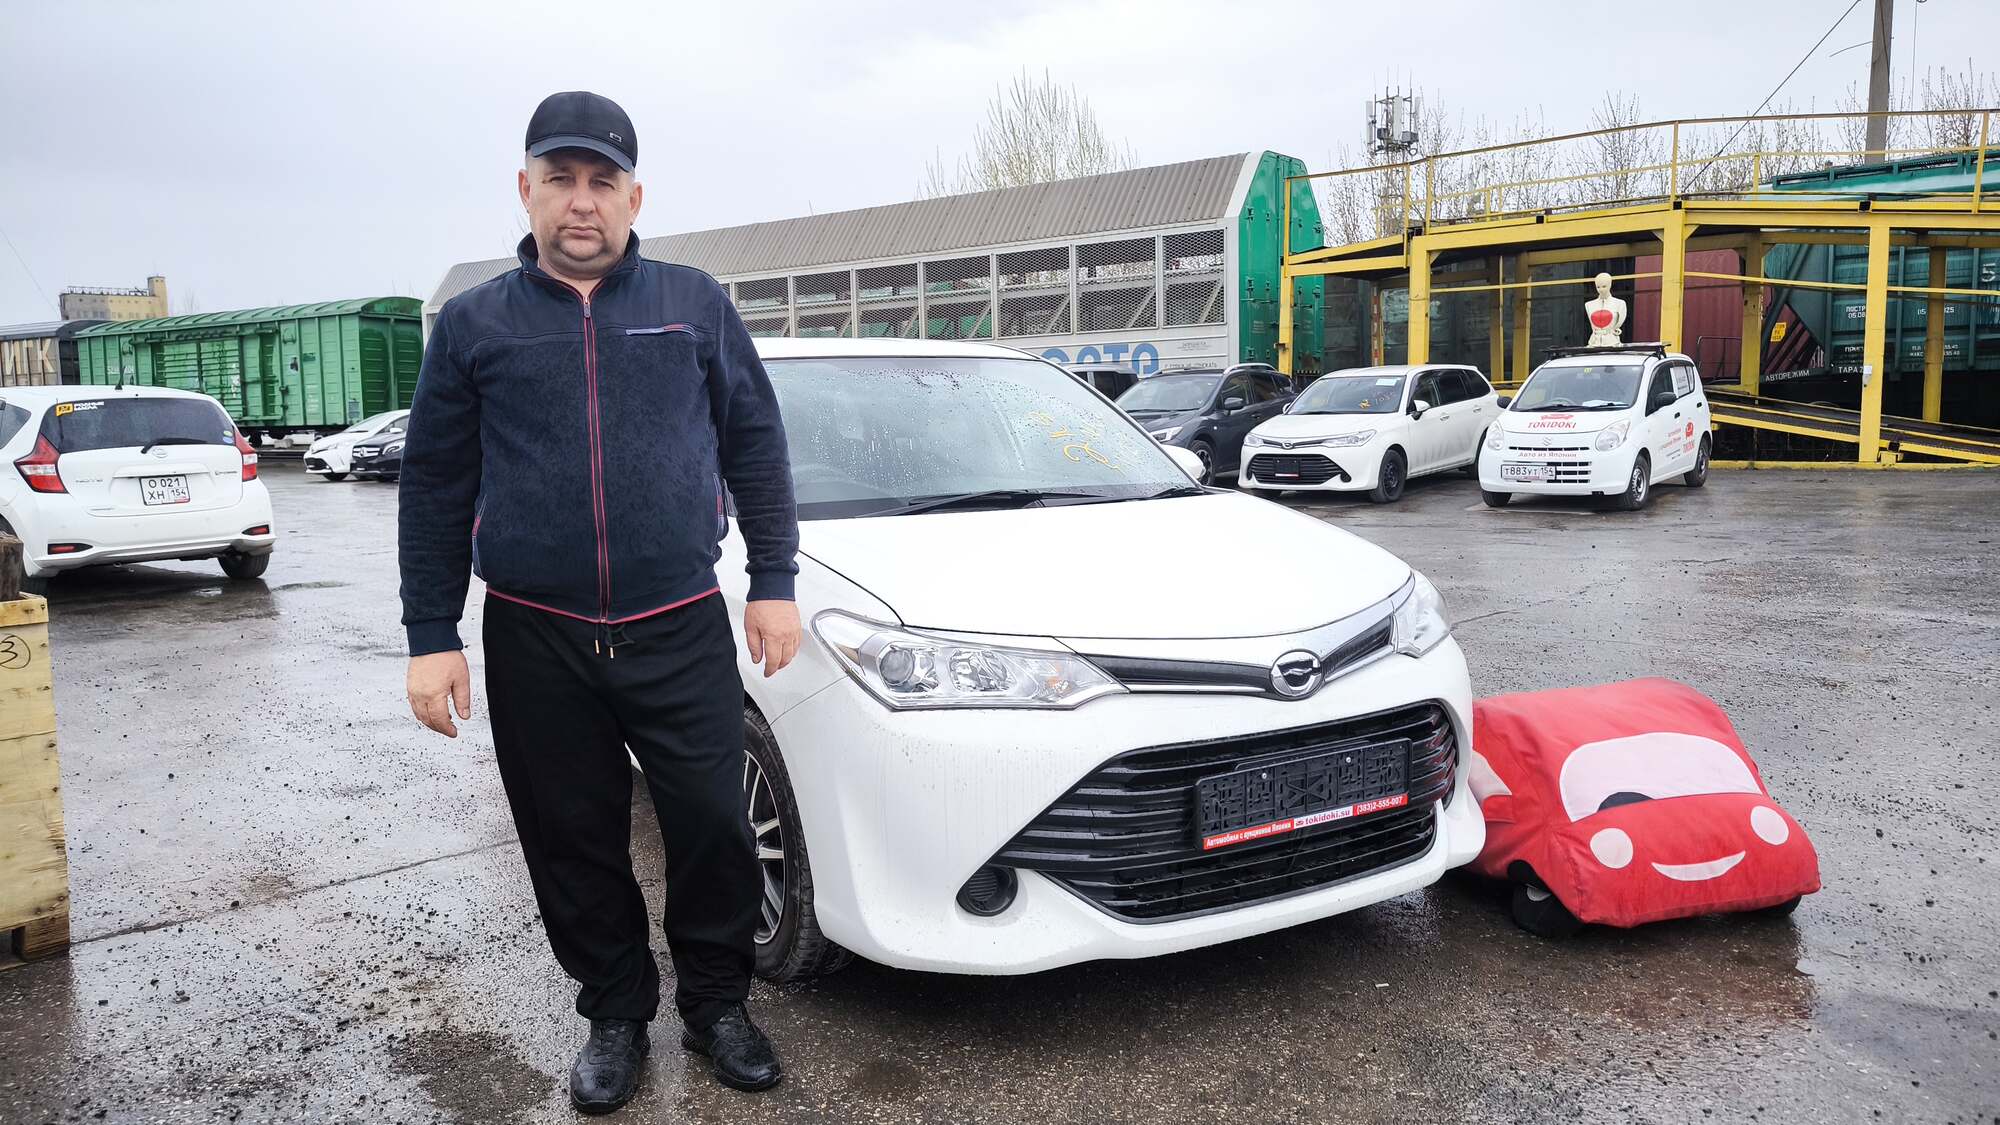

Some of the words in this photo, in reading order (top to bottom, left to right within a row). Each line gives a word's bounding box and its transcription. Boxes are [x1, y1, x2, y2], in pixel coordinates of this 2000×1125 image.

[1765, 369, 1810, 382] АВТОРЕЖИМ
[1528, 421, 1577, 430] TOKIDOKI
[160, 477, 180, 488] 021
[147, 490, 165, 501] ХН
[171, 488, 187, 497] 154
[1305, 808, 1350, 825] tokidoki.su
